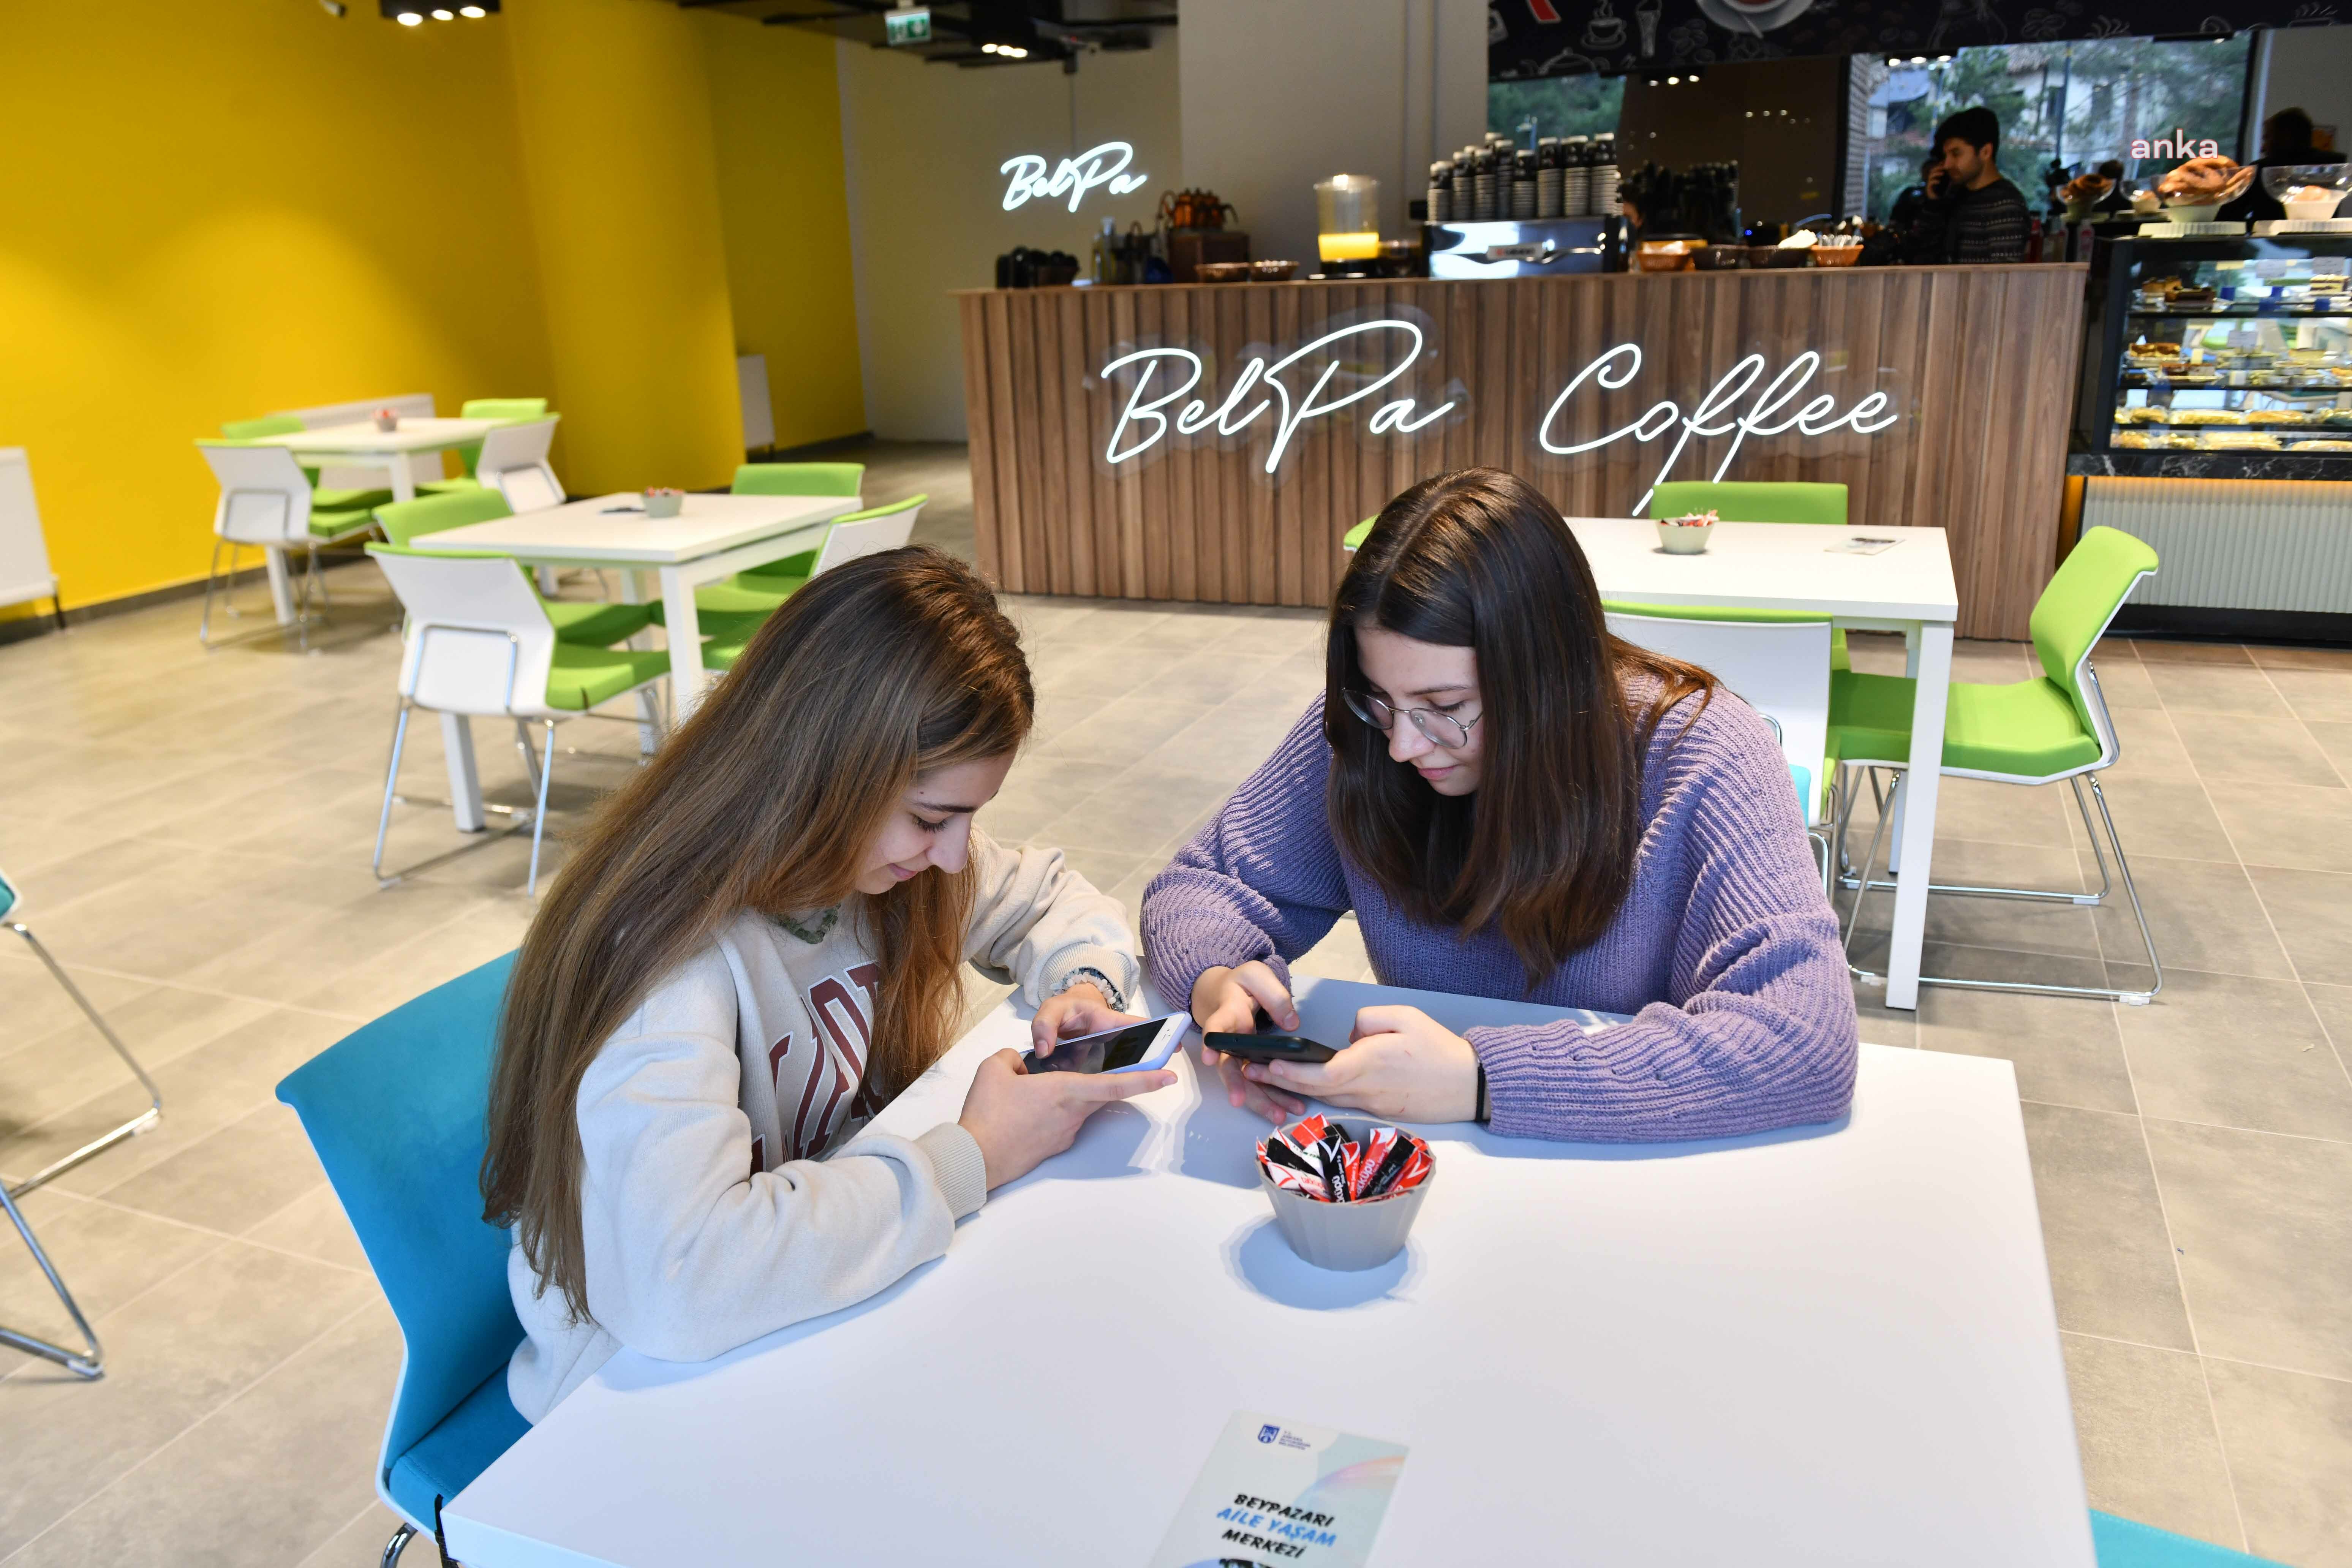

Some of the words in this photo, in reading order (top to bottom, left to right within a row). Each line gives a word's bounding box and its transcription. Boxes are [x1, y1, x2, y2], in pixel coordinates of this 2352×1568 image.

[1000, 141, 1147, 213] BelPa
[1100, 320, 1455, 474] BelPa
[1540, 343, 1898, 517] Coffee
[1216, 1506, 1265, 1528] AİLE
[1268, 1518, 1337, 1548] YAŞAM
[1234, 1494, 1335, 1527] BEYPAZARI
[1221, 1529, 1307, 1559] MERKEZİ
